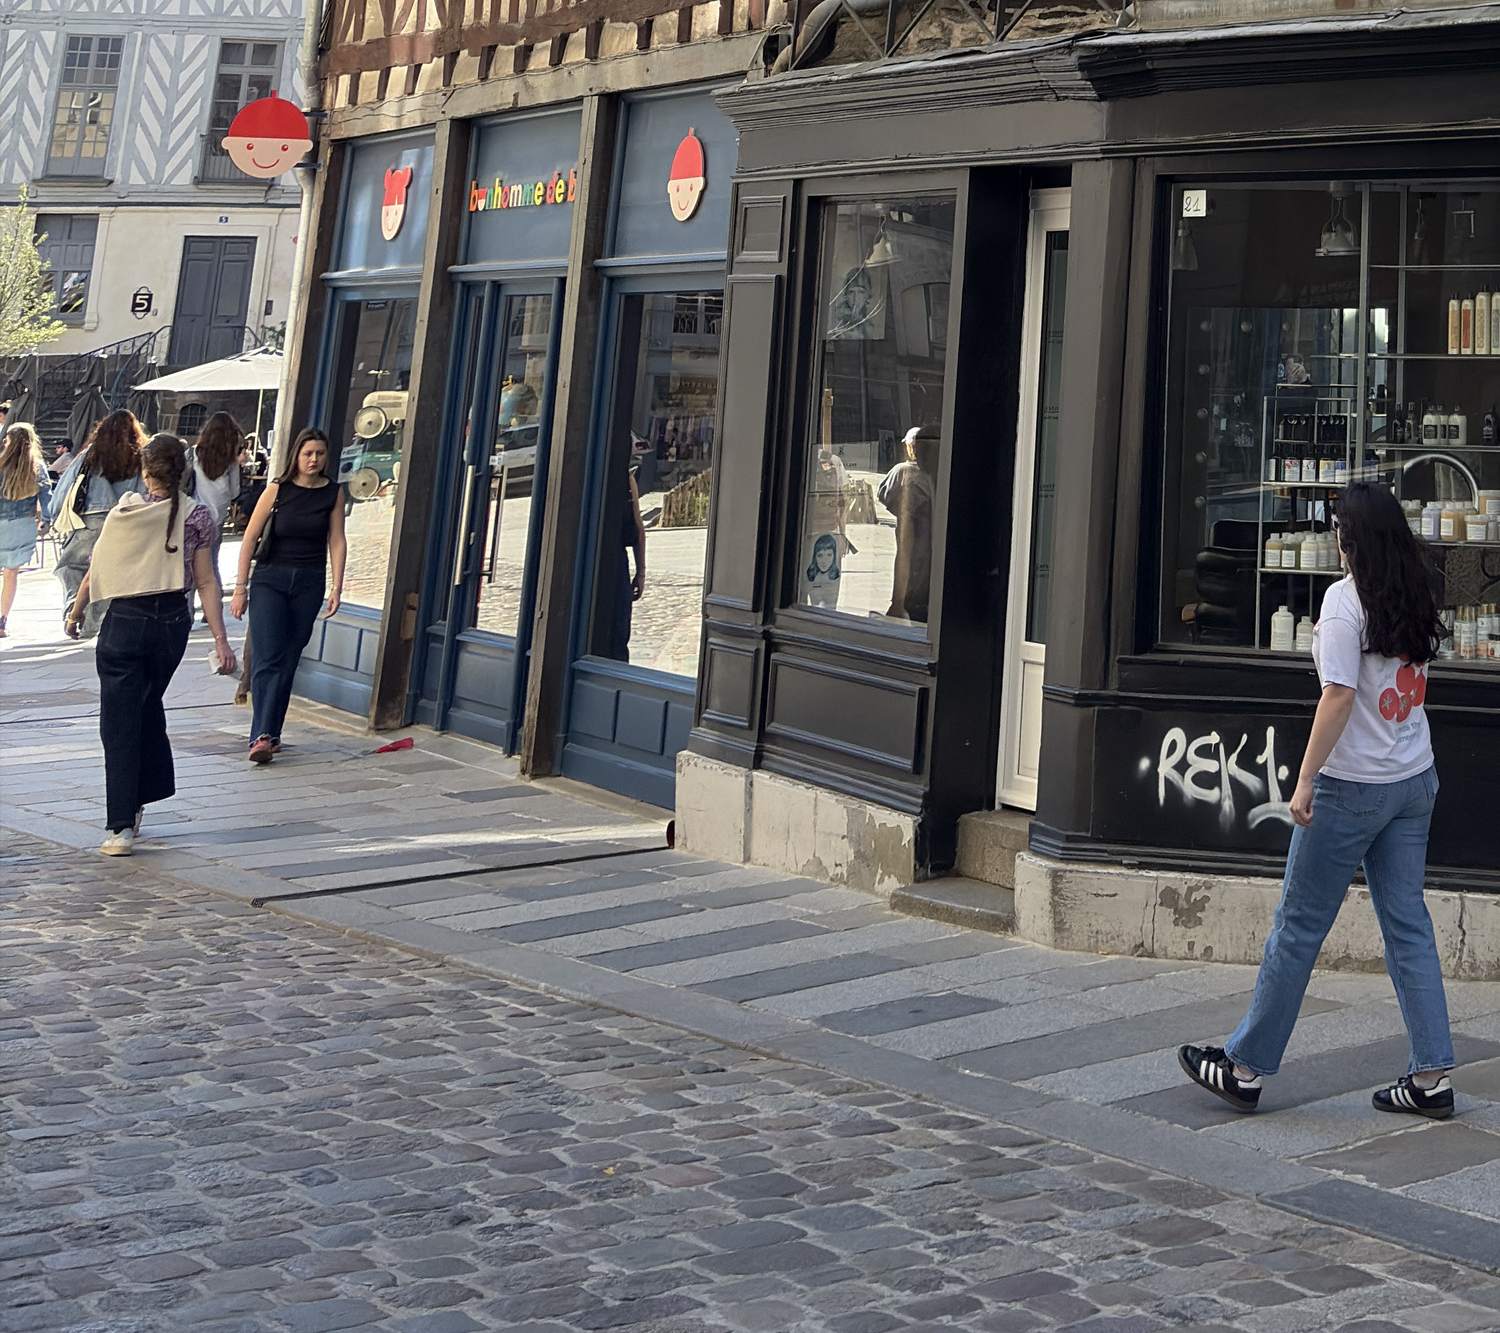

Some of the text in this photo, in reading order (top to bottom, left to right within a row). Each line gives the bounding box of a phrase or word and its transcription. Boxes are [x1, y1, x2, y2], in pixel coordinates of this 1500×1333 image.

[469, 177, 544, 212] bonhomme
[546, 170, 565, 204] de
[1184, 196, 1201, 212] 21
[134, 295, 149, 311] 5
